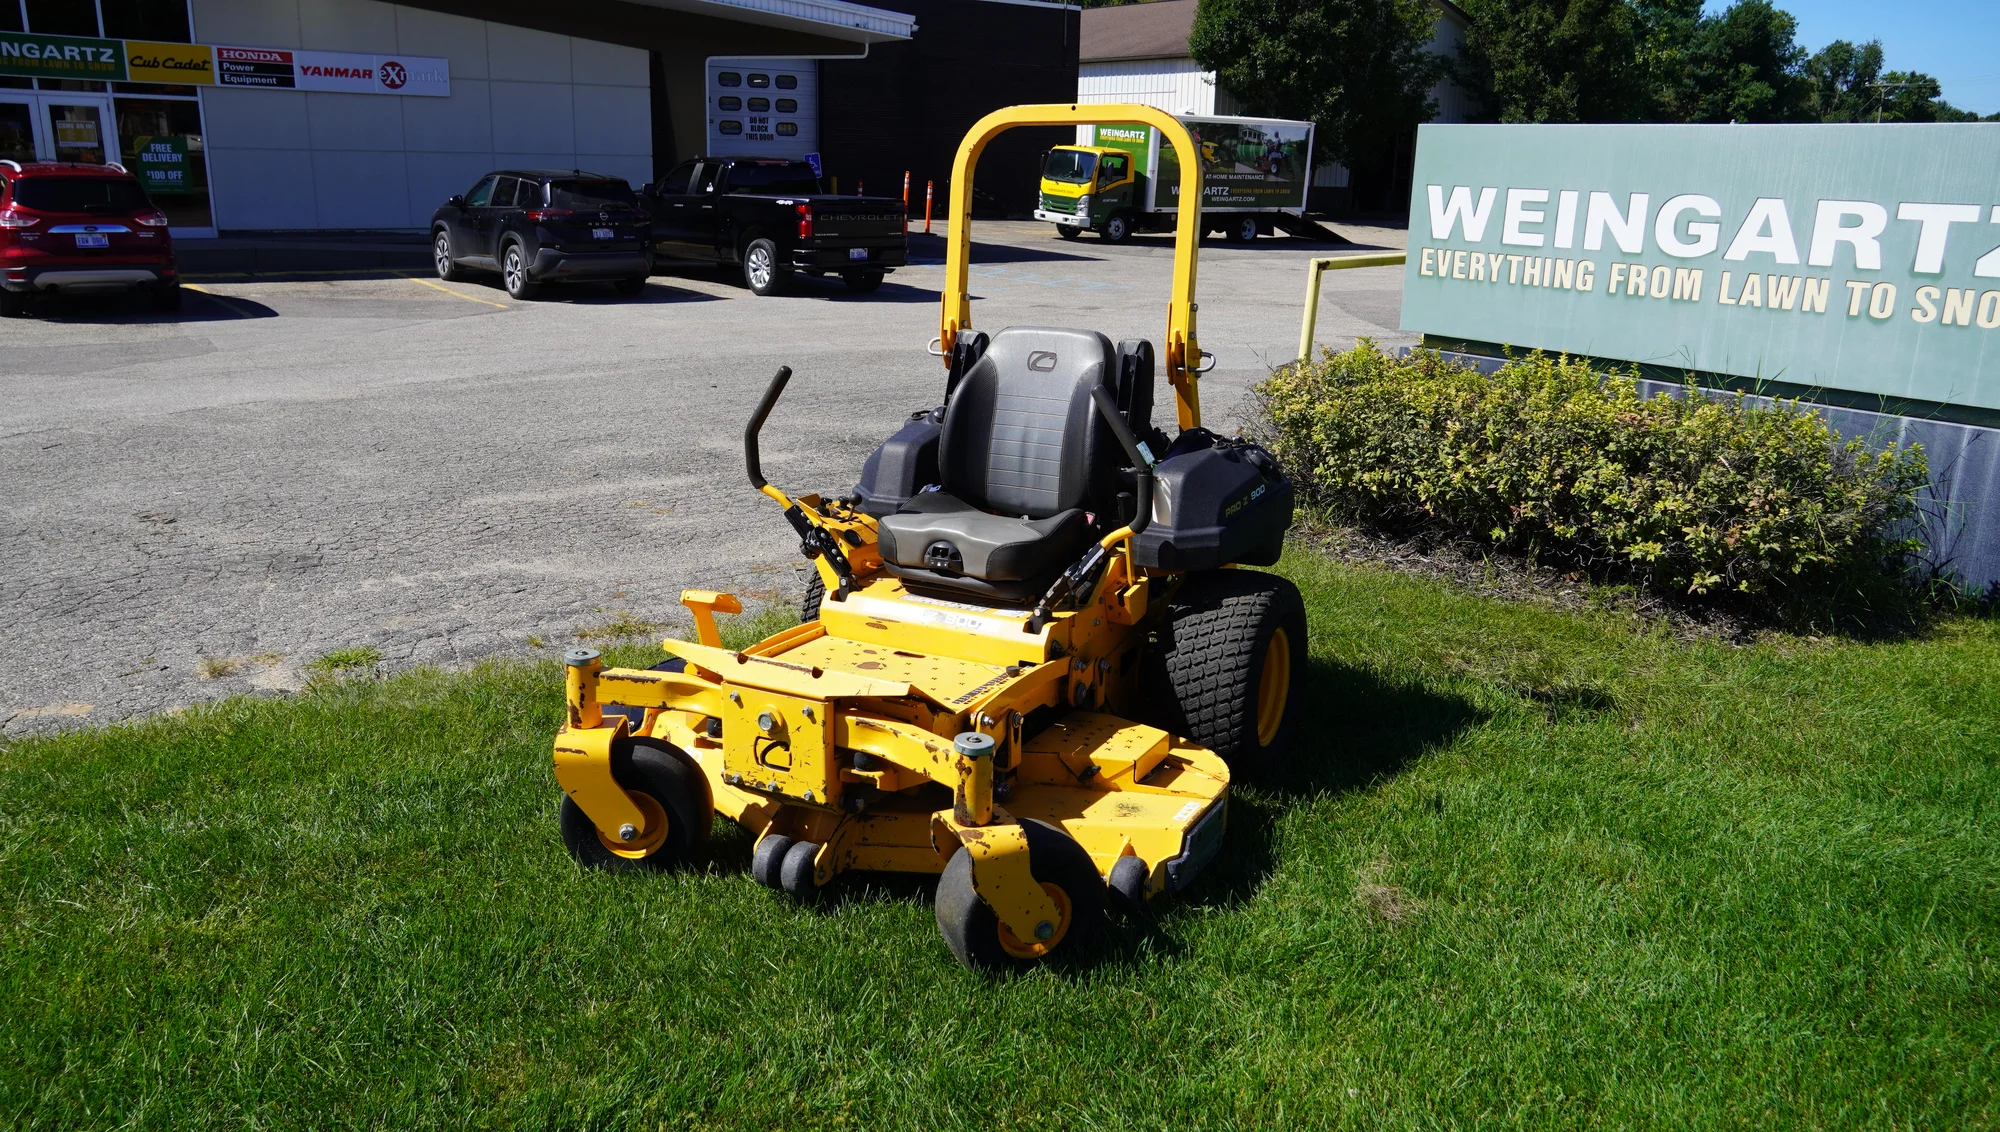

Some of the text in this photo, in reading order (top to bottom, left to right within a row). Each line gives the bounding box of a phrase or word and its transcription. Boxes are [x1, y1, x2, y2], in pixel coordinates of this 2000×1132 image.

[222, 50, 283, 62] HONDA
[12, 57, 40, 67] FROM
[43, 60, 70, 69] LAWN
[74, 62, 84, 70] TO
[88, 62, 116, 72] SNOW
[129, 55, 211, 72] Cub Cadet
[222, 62, 254, 72] Power
[300, 65, 373, 79] YANMAR
[224, 74, 277, 85] Equipment
[1100, 128, 1145, 140] WEINGARTZ
[150, 143, 172, 152] FREE
[142, 152, 182, 162] DELIVERY
[146, 170, 183, 180] $100 OFF
[1420, 247, 1595, 292] EVERYTHING
[1608, 262, 1703, 301] FROM
[1718, 271, 1830, 313] LAWN
[1845, 280, 1897, 319] TO
[1225, 484, 1266, 518] PRO Z 900
